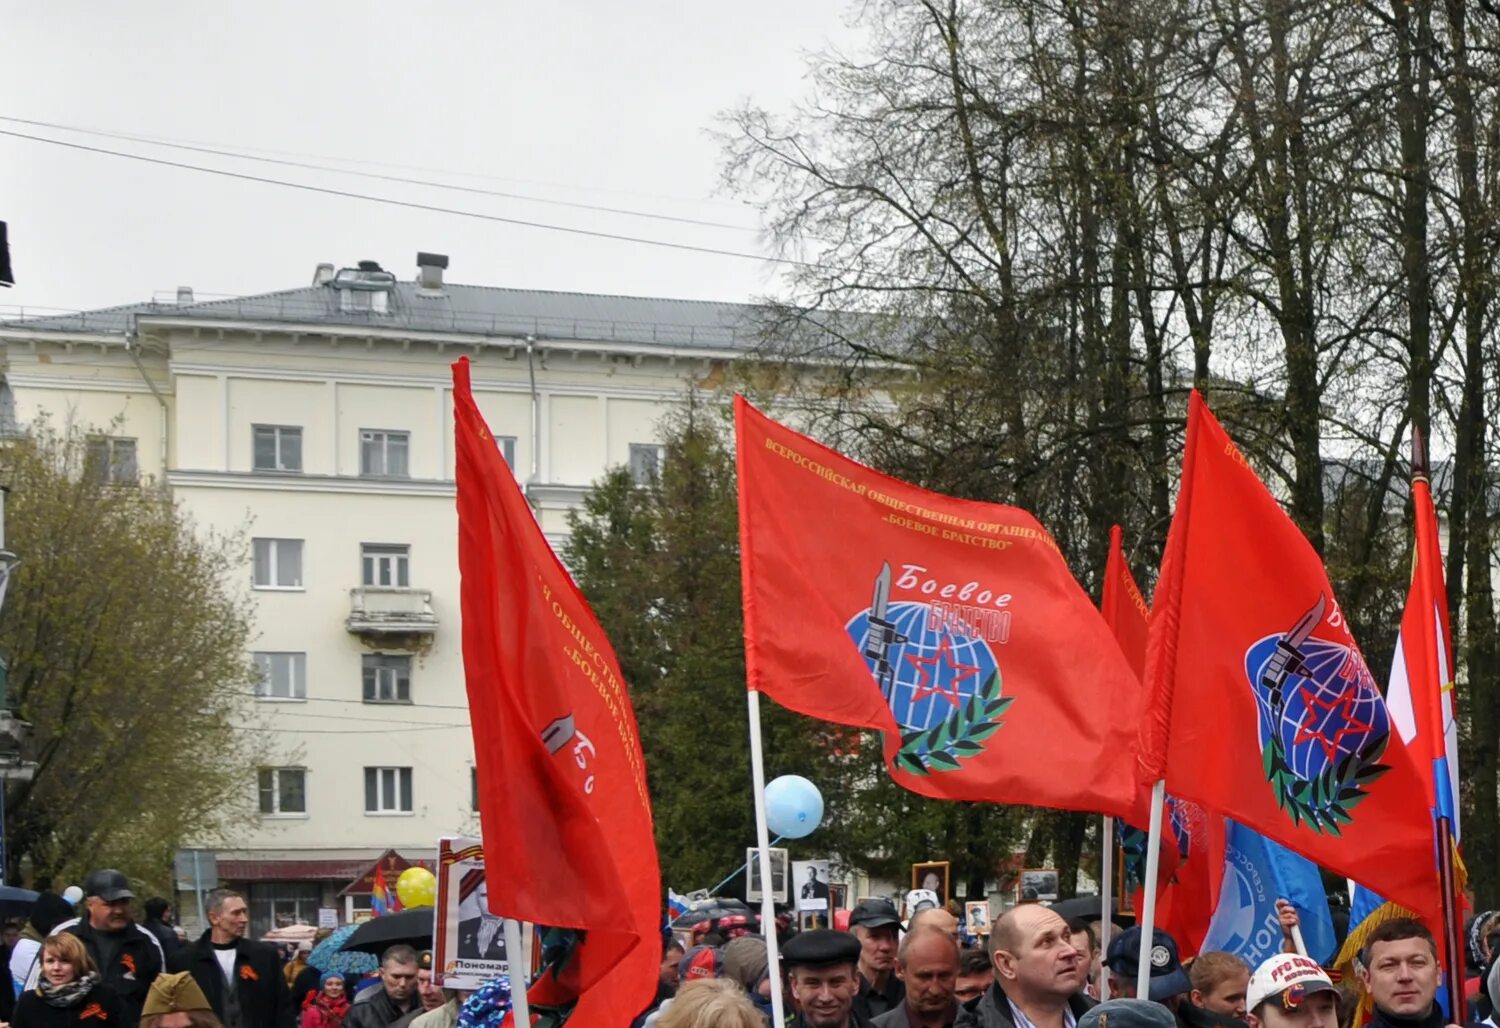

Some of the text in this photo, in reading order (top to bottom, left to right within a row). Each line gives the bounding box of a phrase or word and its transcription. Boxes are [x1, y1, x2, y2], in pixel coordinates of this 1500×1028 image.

[765, 438, 867, 496] ВСЕРОССИЙСКАЯ
[867, 489, 975, 529] ОБЩЕСТВЕННАЯ
[896, 563, 1013, 608] Боевое
[928, 600, 1012, 644] БРАТСТВО
[456, 961, 509, 971] Пономар
